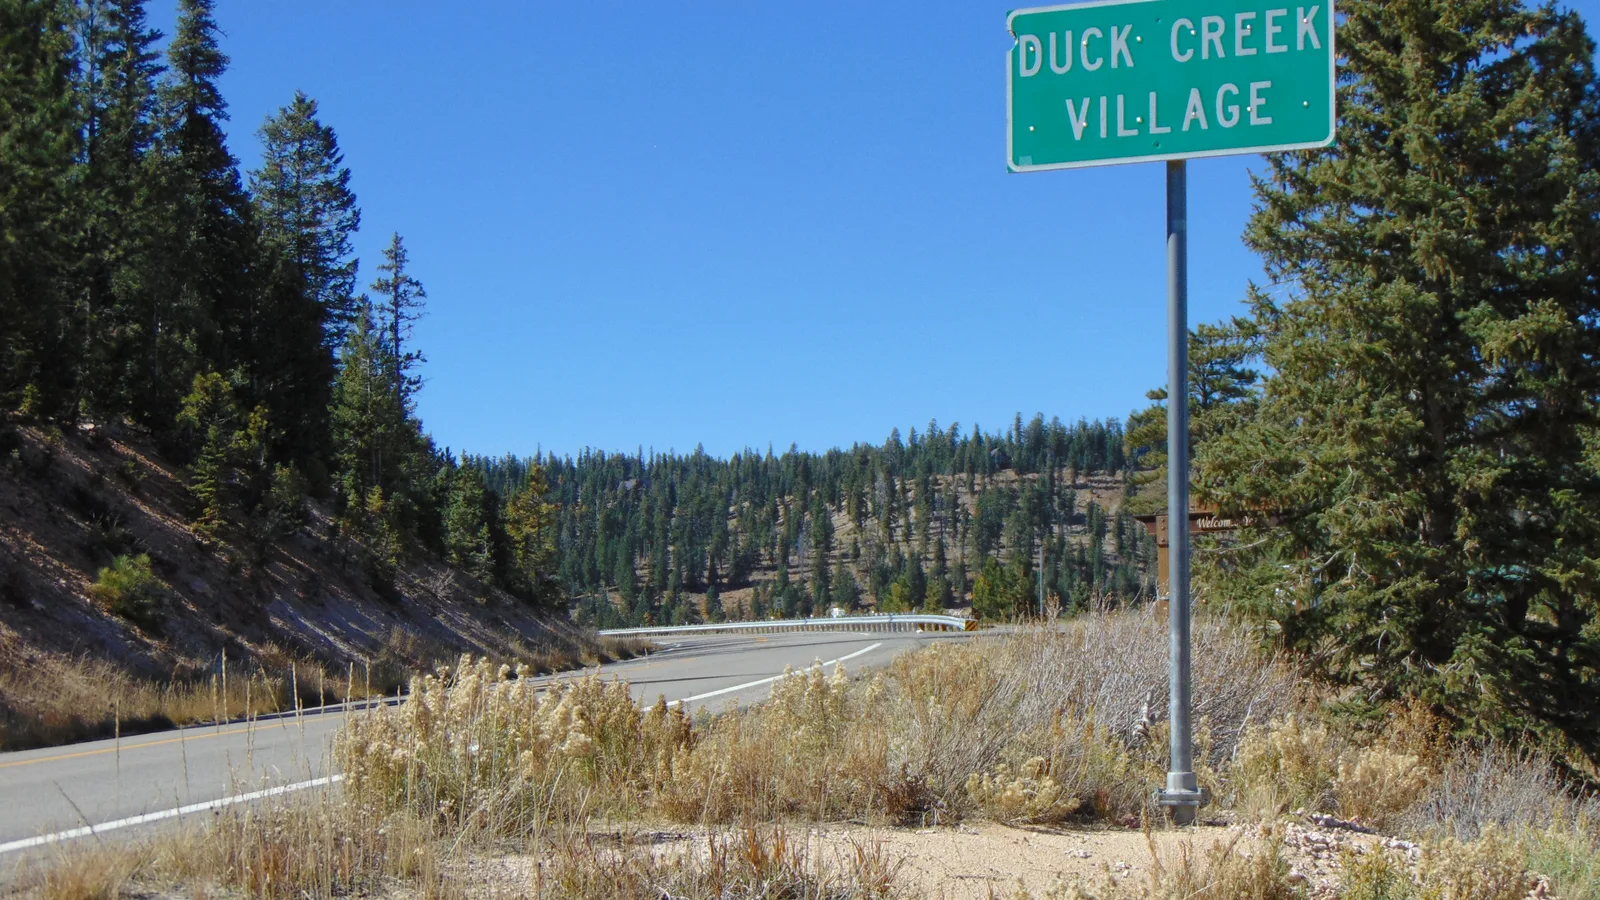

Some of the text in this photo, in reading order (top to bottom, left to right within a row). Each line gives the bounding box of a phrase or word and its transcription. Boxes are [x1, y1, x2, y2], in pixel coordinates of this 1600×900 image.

[1019, 5, 1321, 77] DUCK CREEK
[1065, 80, 1273, 141] VILLAGE
[1196, 515, 1239, 529] Welcom
